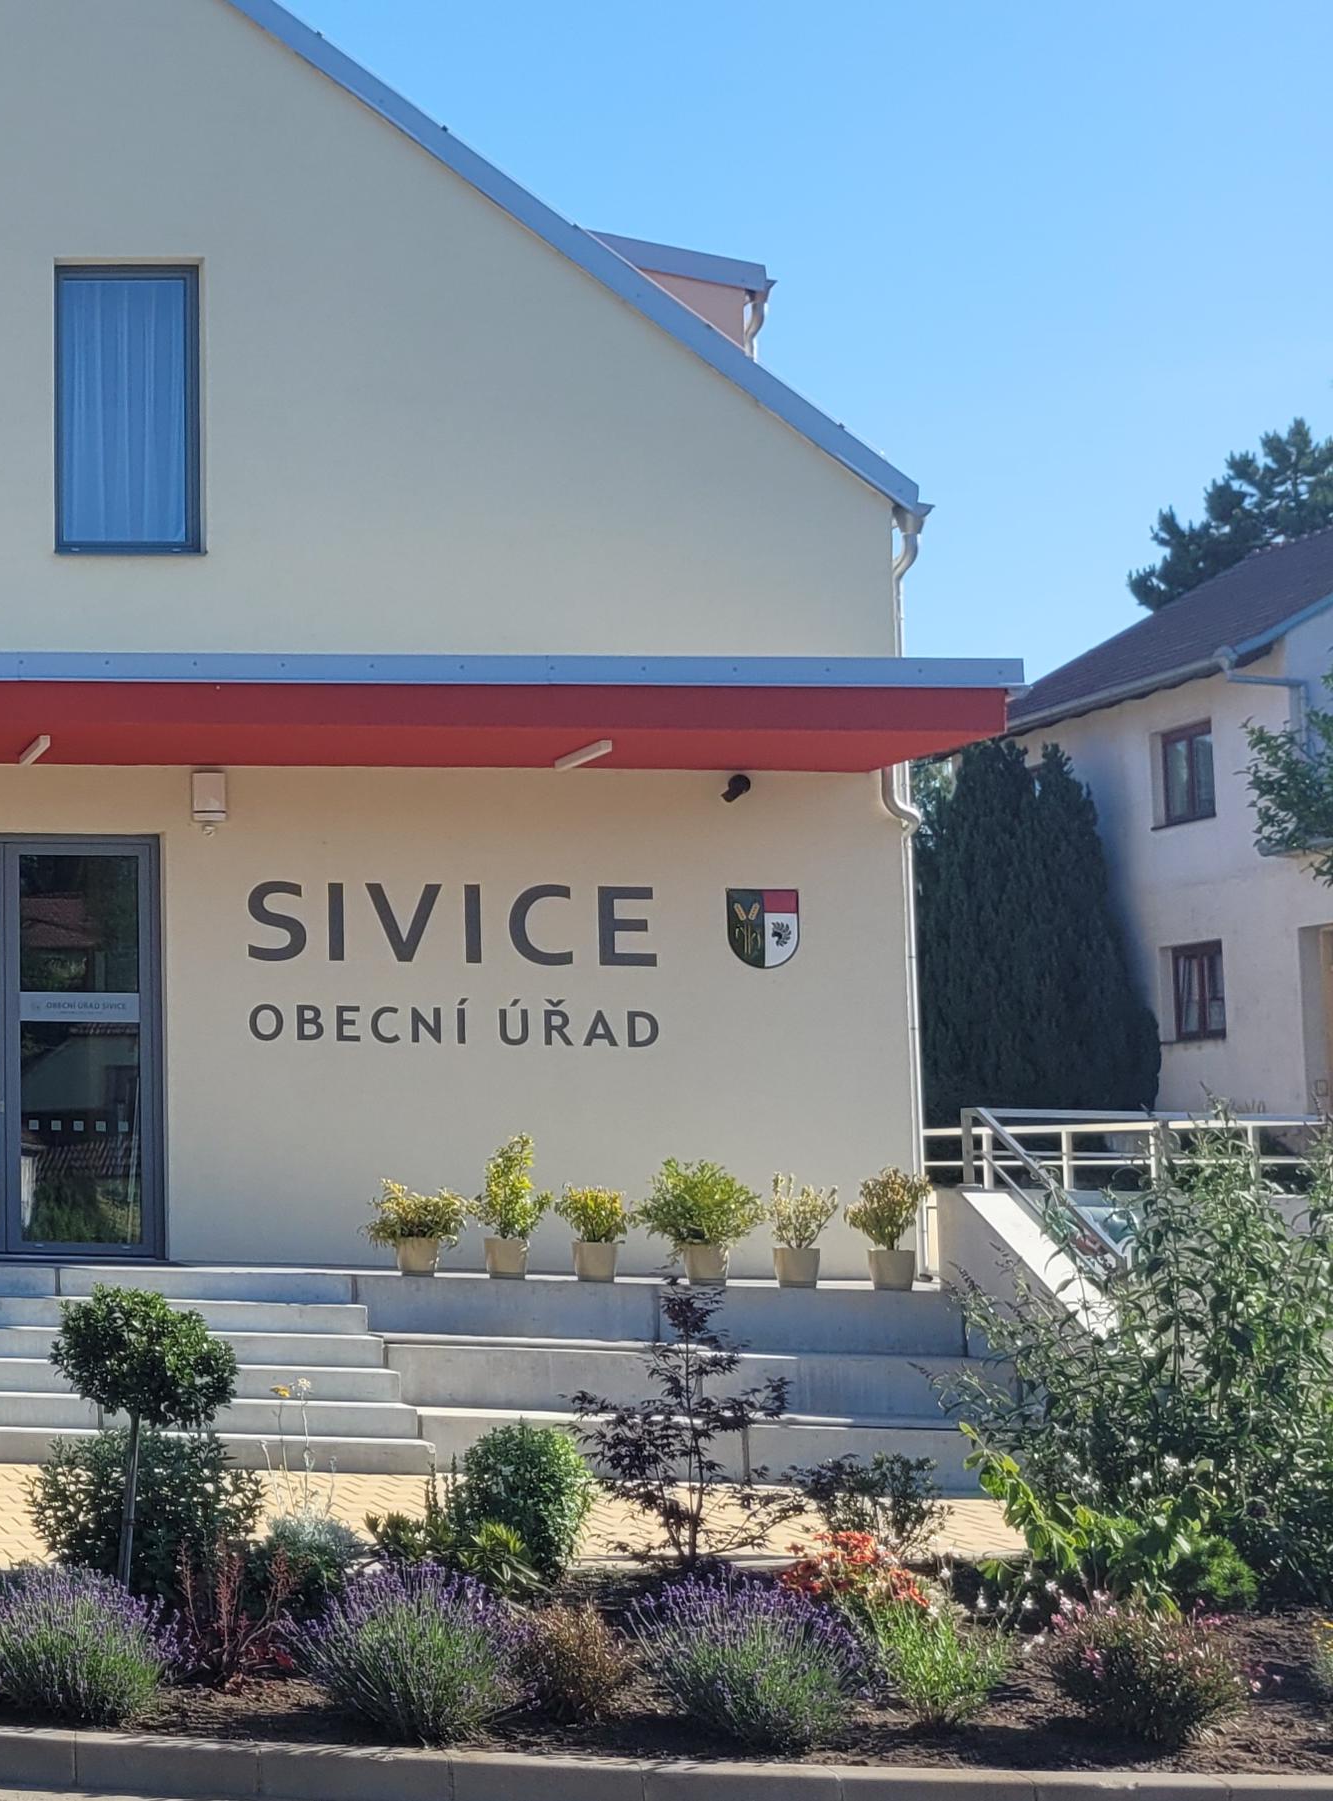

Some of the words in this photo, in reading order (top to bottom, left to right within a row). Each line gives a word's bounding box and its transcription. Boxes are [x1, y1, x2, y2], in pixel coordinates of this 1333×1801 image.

[247, 880, 658, 968] SIVICE
[46, 1001, 75, 1009] OBECNÍ
[102, 1002, 127, 1010] SIVICE
[248, 997, 469, 1045] OBECNÍ
[498, 998, 660, 1048] ÚŘAD
